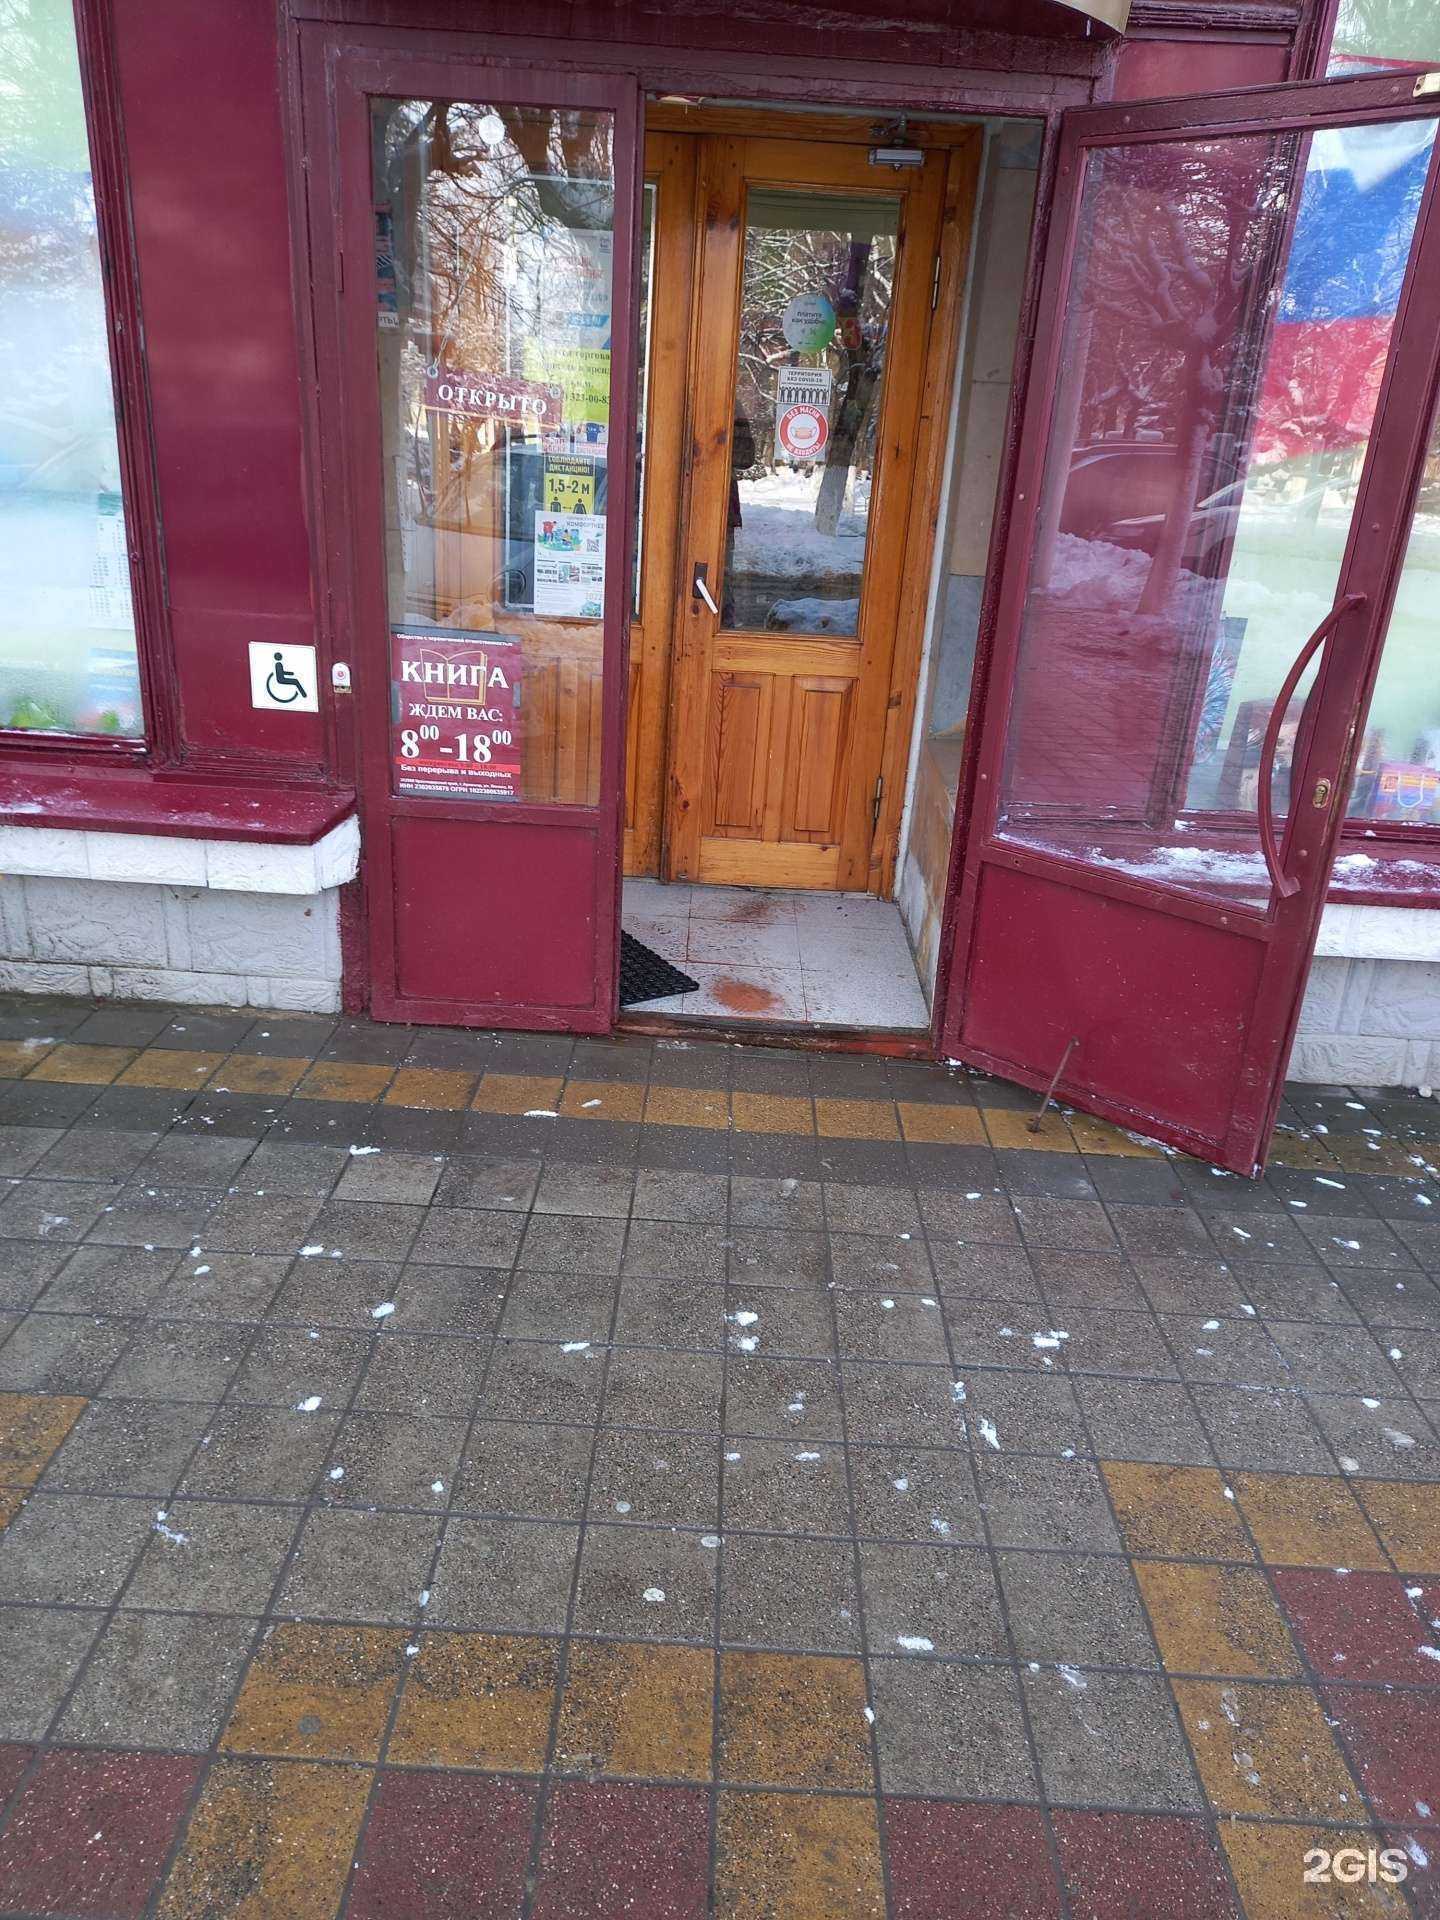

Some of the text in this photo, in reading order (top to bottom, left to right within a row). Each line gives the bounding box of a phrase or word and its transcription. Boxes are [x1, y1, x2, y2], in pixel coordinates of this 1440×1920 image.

[438, 384, 547, 415] ОТКРЫТО
[786, 405, 821, 420] БЕЗ МАСКИ
[548, 455, 591, 465] СОБЛЮДАЙТЕ
[549, 464, 591, 474] ДИСТАНЦИЮ!
[549, 478, 579, 494] 1,5-2
[401, 660, 509, 689] КНИГА
[408, 703, 463, 719] ЖДЕМ
[401, 764, 417, 772] Без
[418, 766, 459, 776] перерыва
[468, 769, 512, 779] выходных
